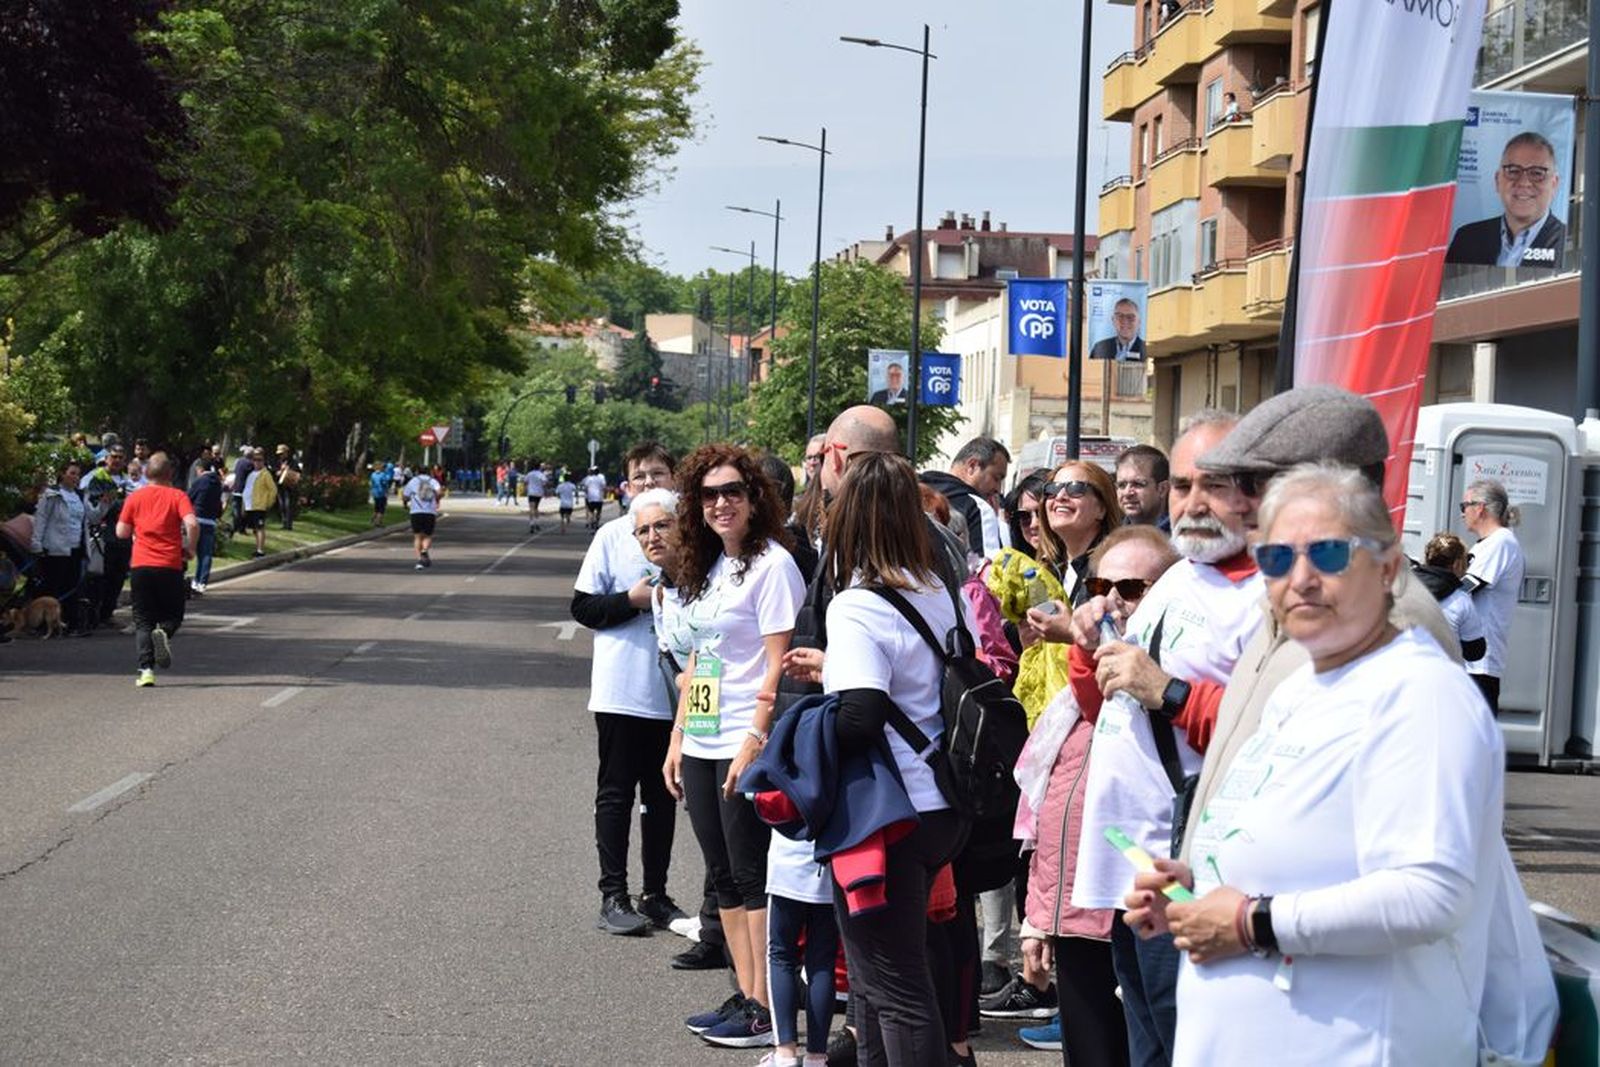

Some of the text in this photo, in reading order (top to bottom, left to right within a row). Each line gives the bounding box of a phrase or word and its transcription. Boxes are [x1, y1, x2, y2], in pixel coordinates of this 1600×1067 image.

[1523, 247, 1555, 261] 28M
[1020, 299, 1056, 312] VOTA
[928, 366, 952, 375] VOTA
